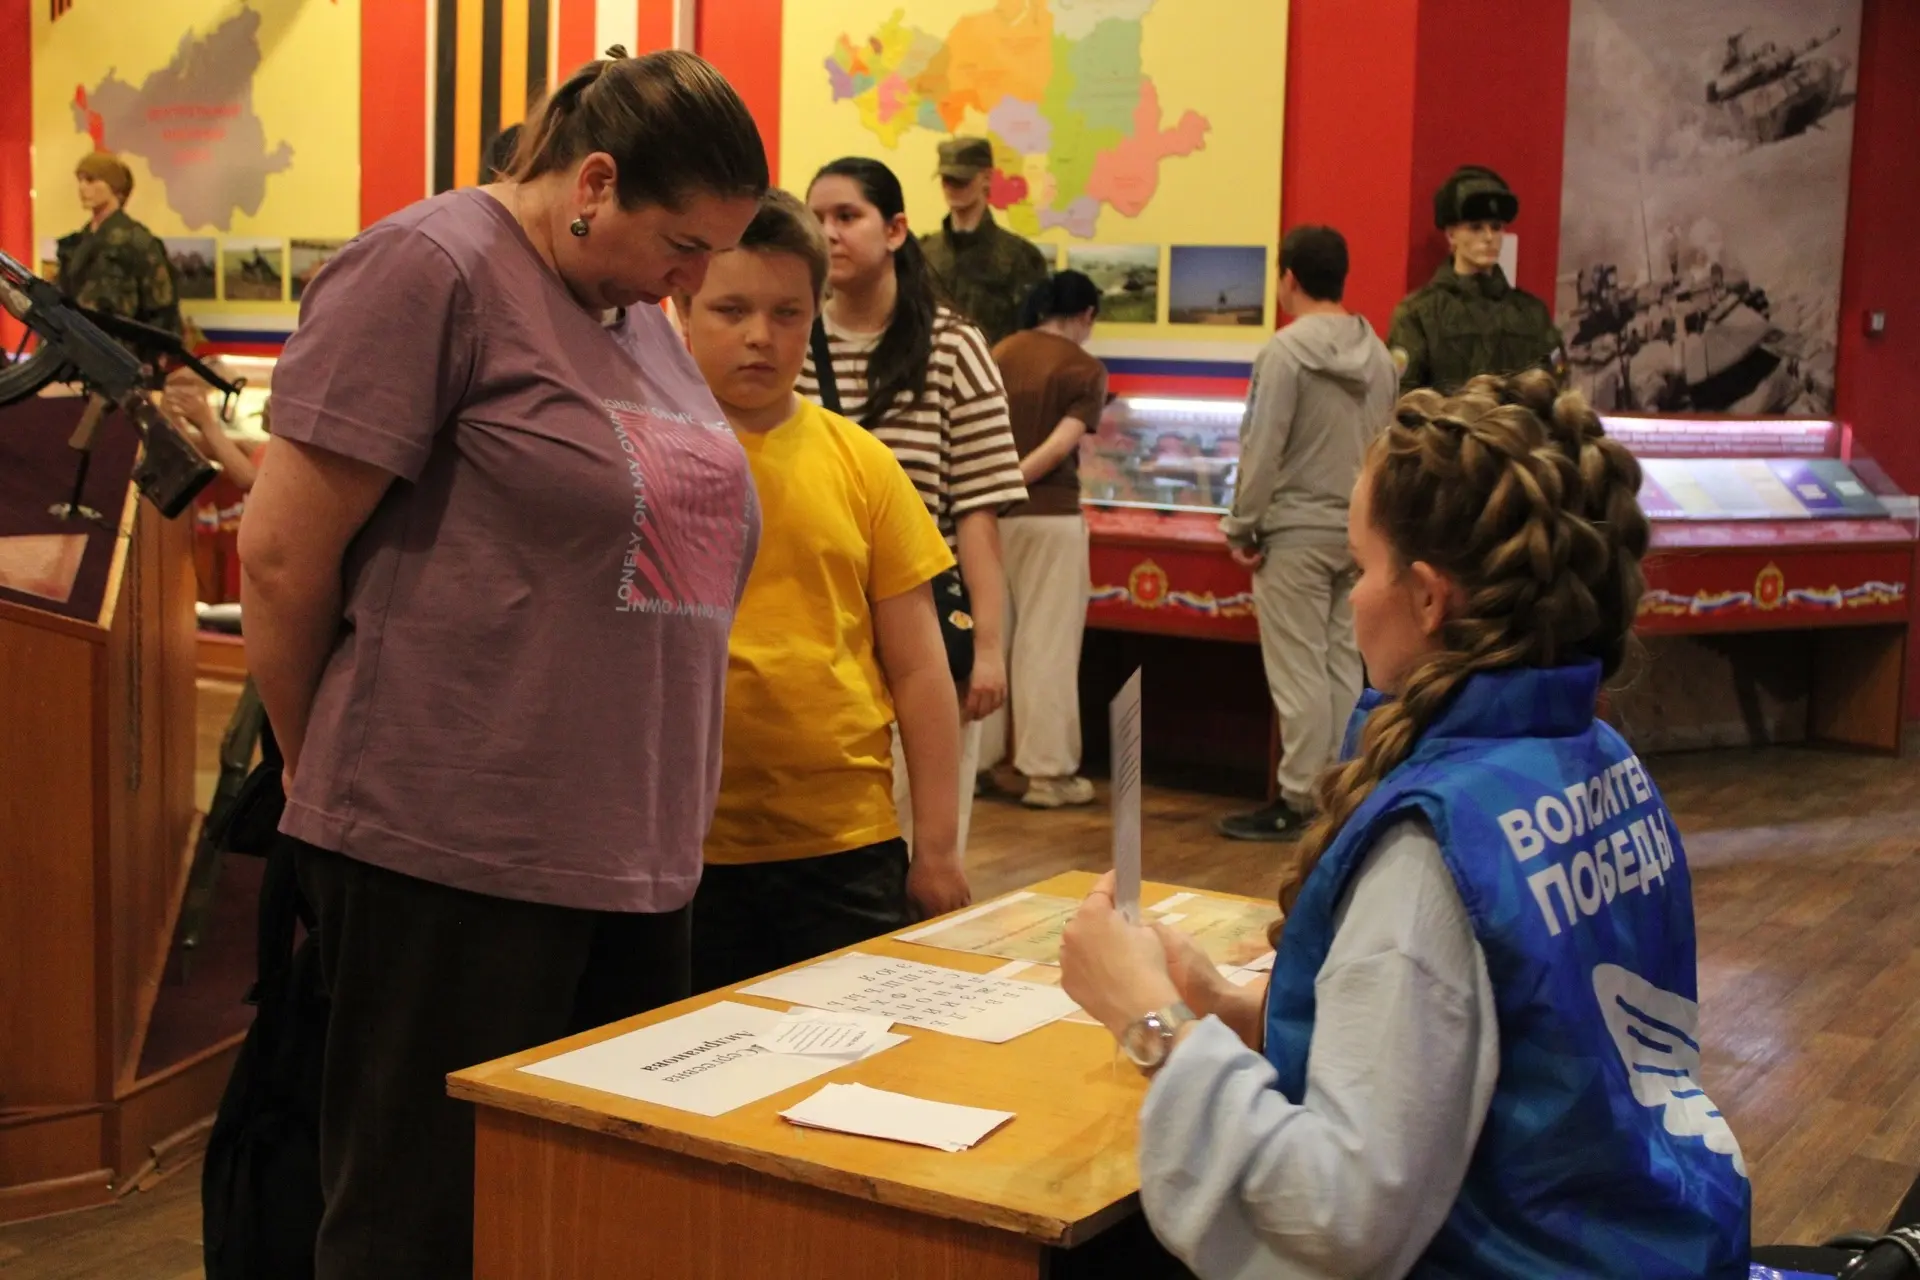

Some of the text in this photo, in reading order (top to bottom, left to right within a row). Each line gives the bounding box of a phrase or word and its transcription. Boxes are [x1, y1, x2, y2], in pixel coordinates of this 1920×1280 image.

[627, 458, 645, 489] MY
[633, 494, 647, 527] ON
[616, 532, 643, 612] LONELY
[1526, 808, 1675, 937] ПОБЕДЫ
[640, 1029, 757, 1072] Андрианова
[661, 1043, 759, 1084] Сергеевна
